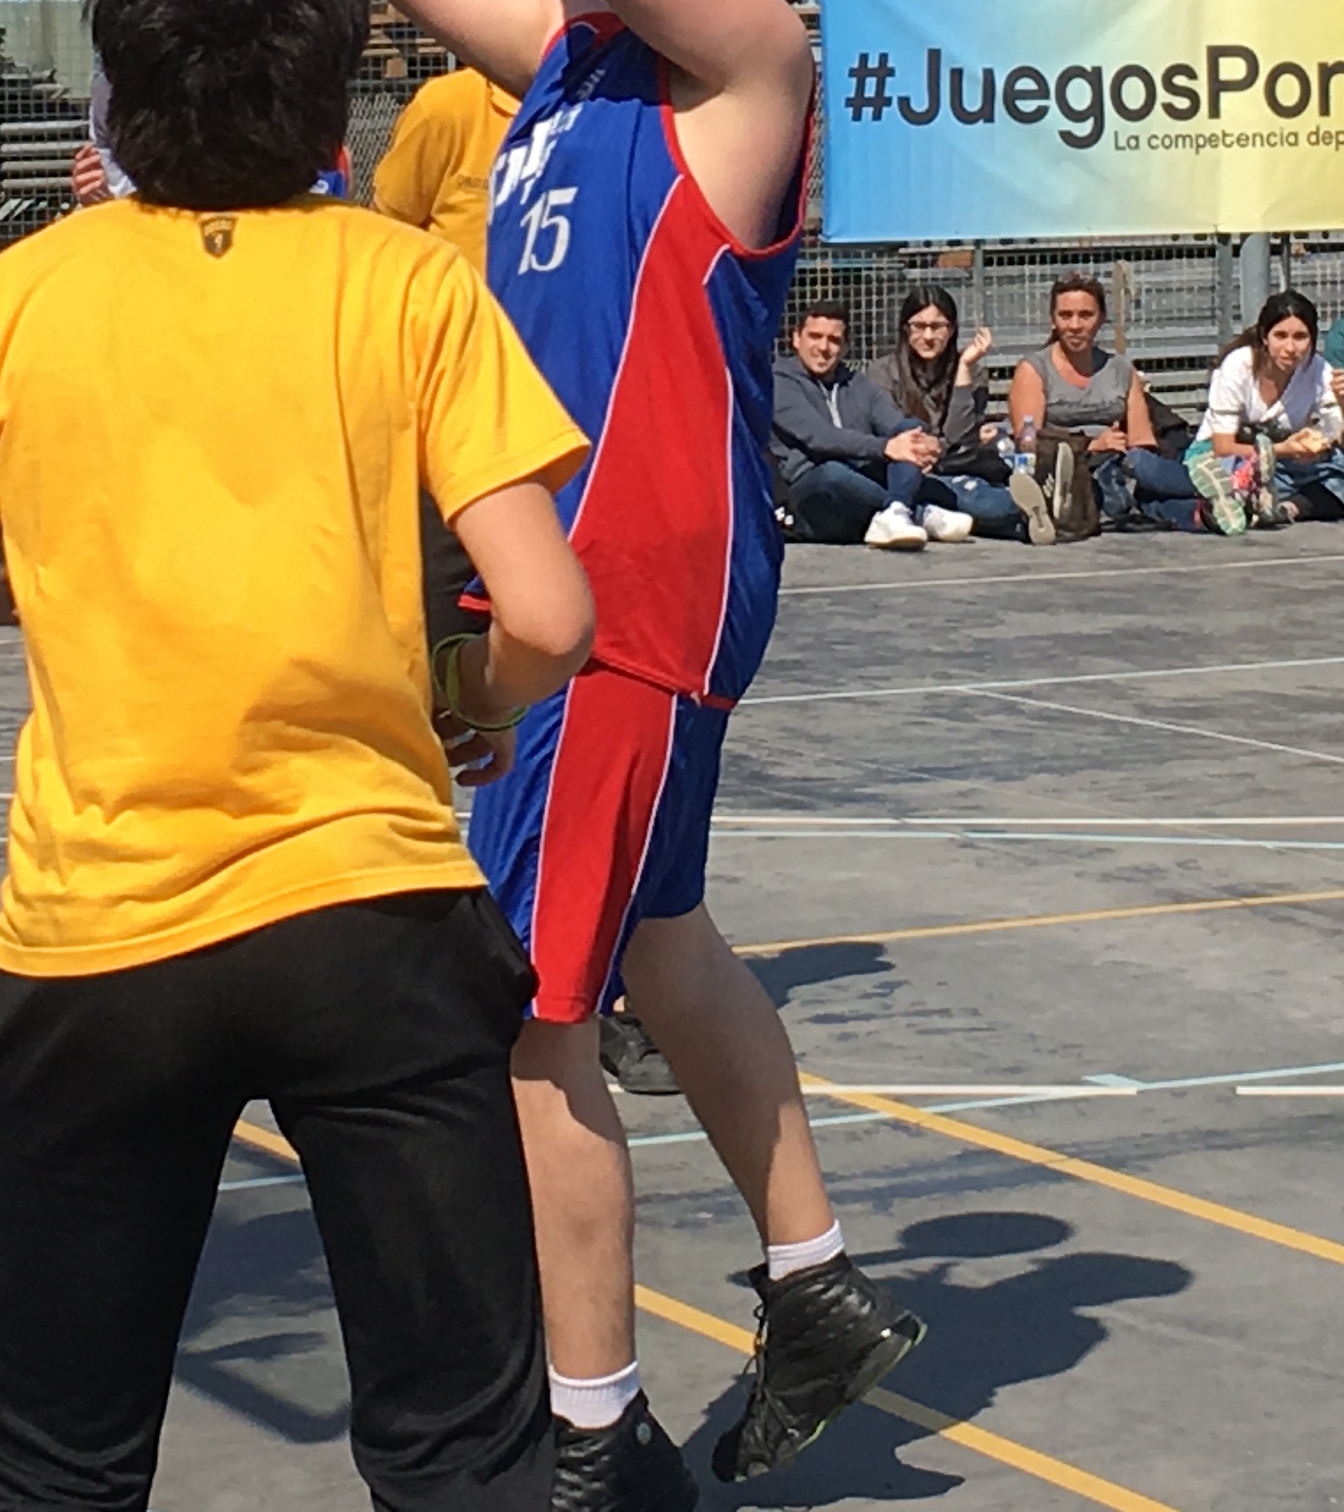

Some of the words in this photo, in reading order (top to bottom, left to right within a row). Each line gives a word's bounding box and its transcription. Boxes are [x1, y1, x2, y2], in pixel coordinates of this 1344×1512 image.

[1114, 130, 1140, 151] La
[1147, 127, 1299, 155] competencia
[518, 187, 579, 275] 15
